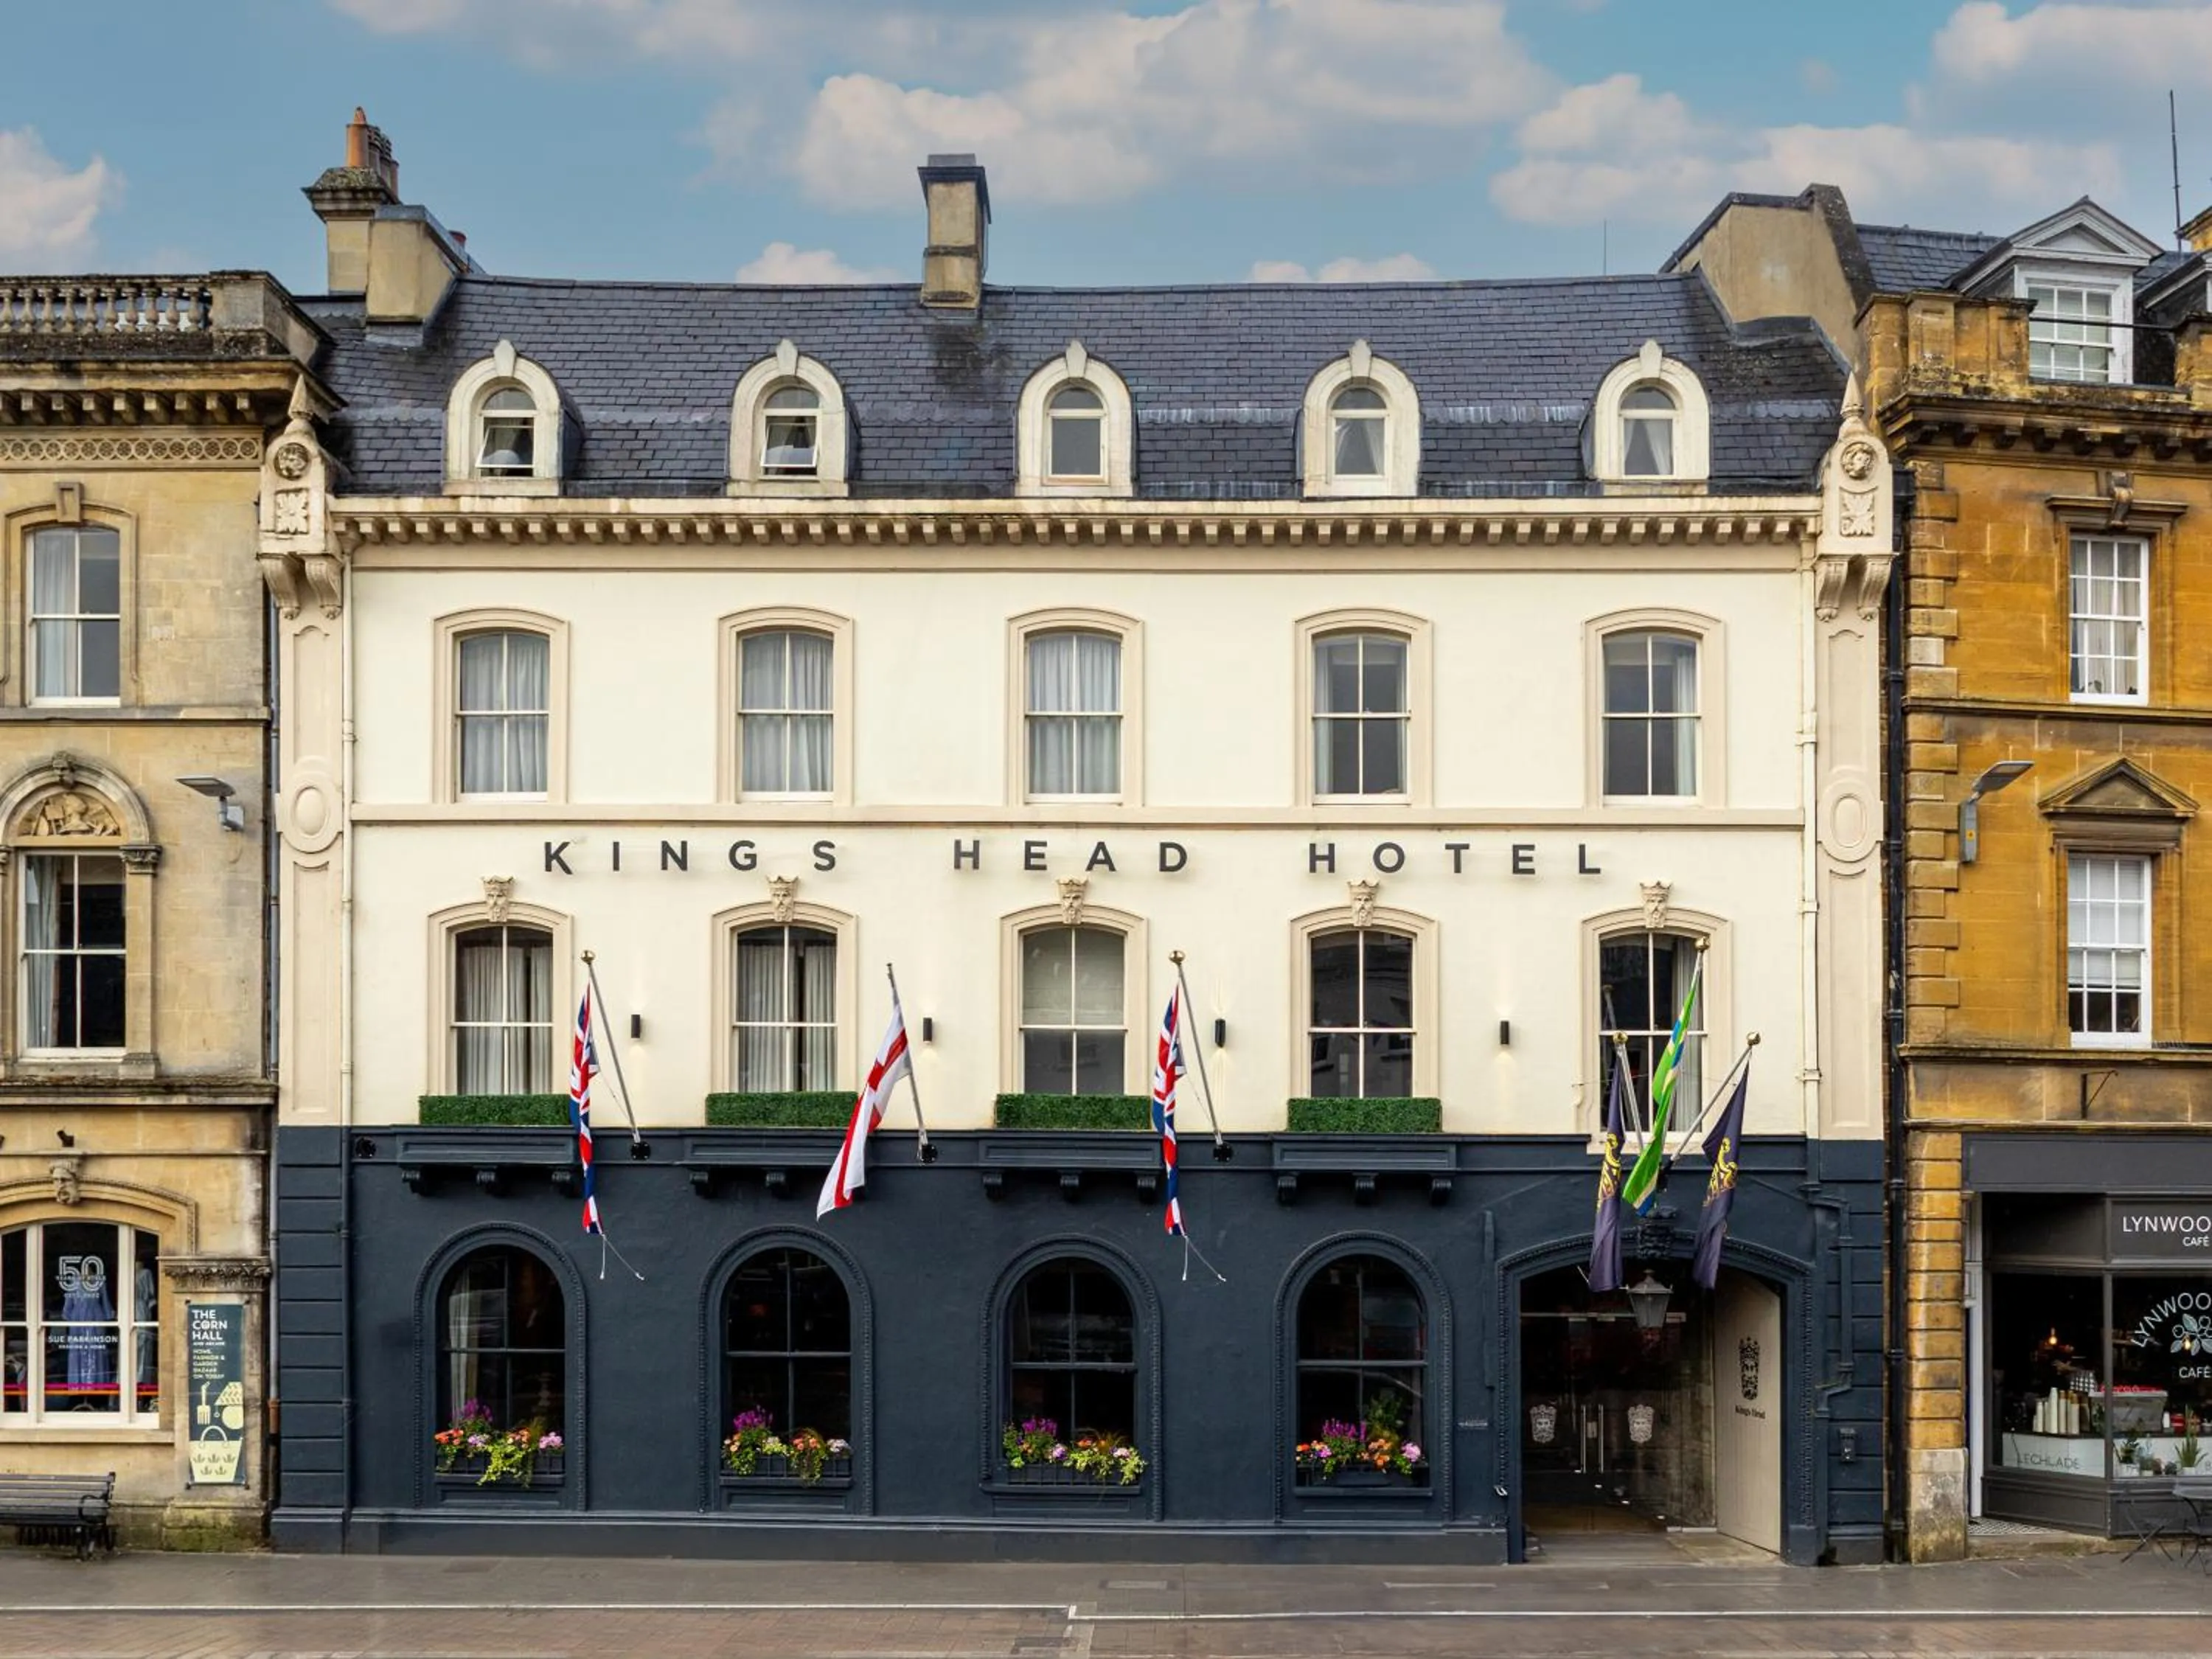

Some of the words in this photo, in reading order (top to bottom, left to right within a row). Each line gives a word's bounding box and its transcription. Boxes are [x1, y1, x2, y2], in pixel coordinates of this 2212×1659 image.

[545, 840, 836, 874] KINGS
[953, 839, 1188, 873] HEAD
[1309, 841, 1601, 875] HOTEL
[2183, 1236, 2210, 1247] CAFÉ
[58, 1255, 104, 1292] 50
[192, 1309, 216, 1319] THE
[192, 1320, 228, 1329] CORN
[192, 1330, 223, 1340] HALL
[2179, 1366, 2212, 1379] CAFÉ
[2016, 1451, 2080, 1470] LECHLADE
